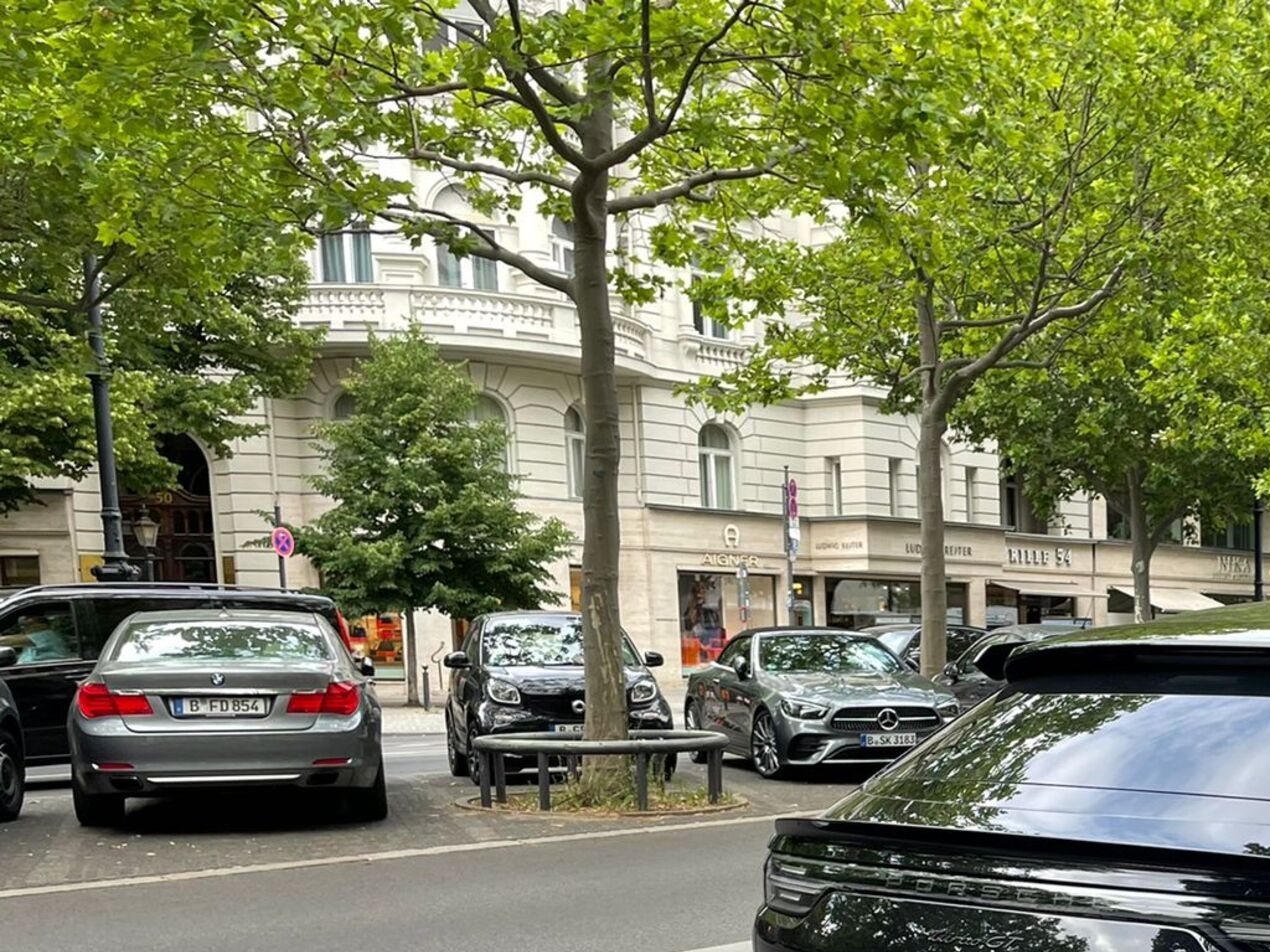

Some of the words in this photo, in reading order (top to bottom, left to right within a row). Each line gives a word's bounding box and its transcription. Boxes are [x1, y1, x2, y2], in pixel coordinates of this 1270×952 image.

[155, 492, 173, 504] 50
[190, 700, 200, 712] B
[885, 875, 1112, 908] PORSCHE
